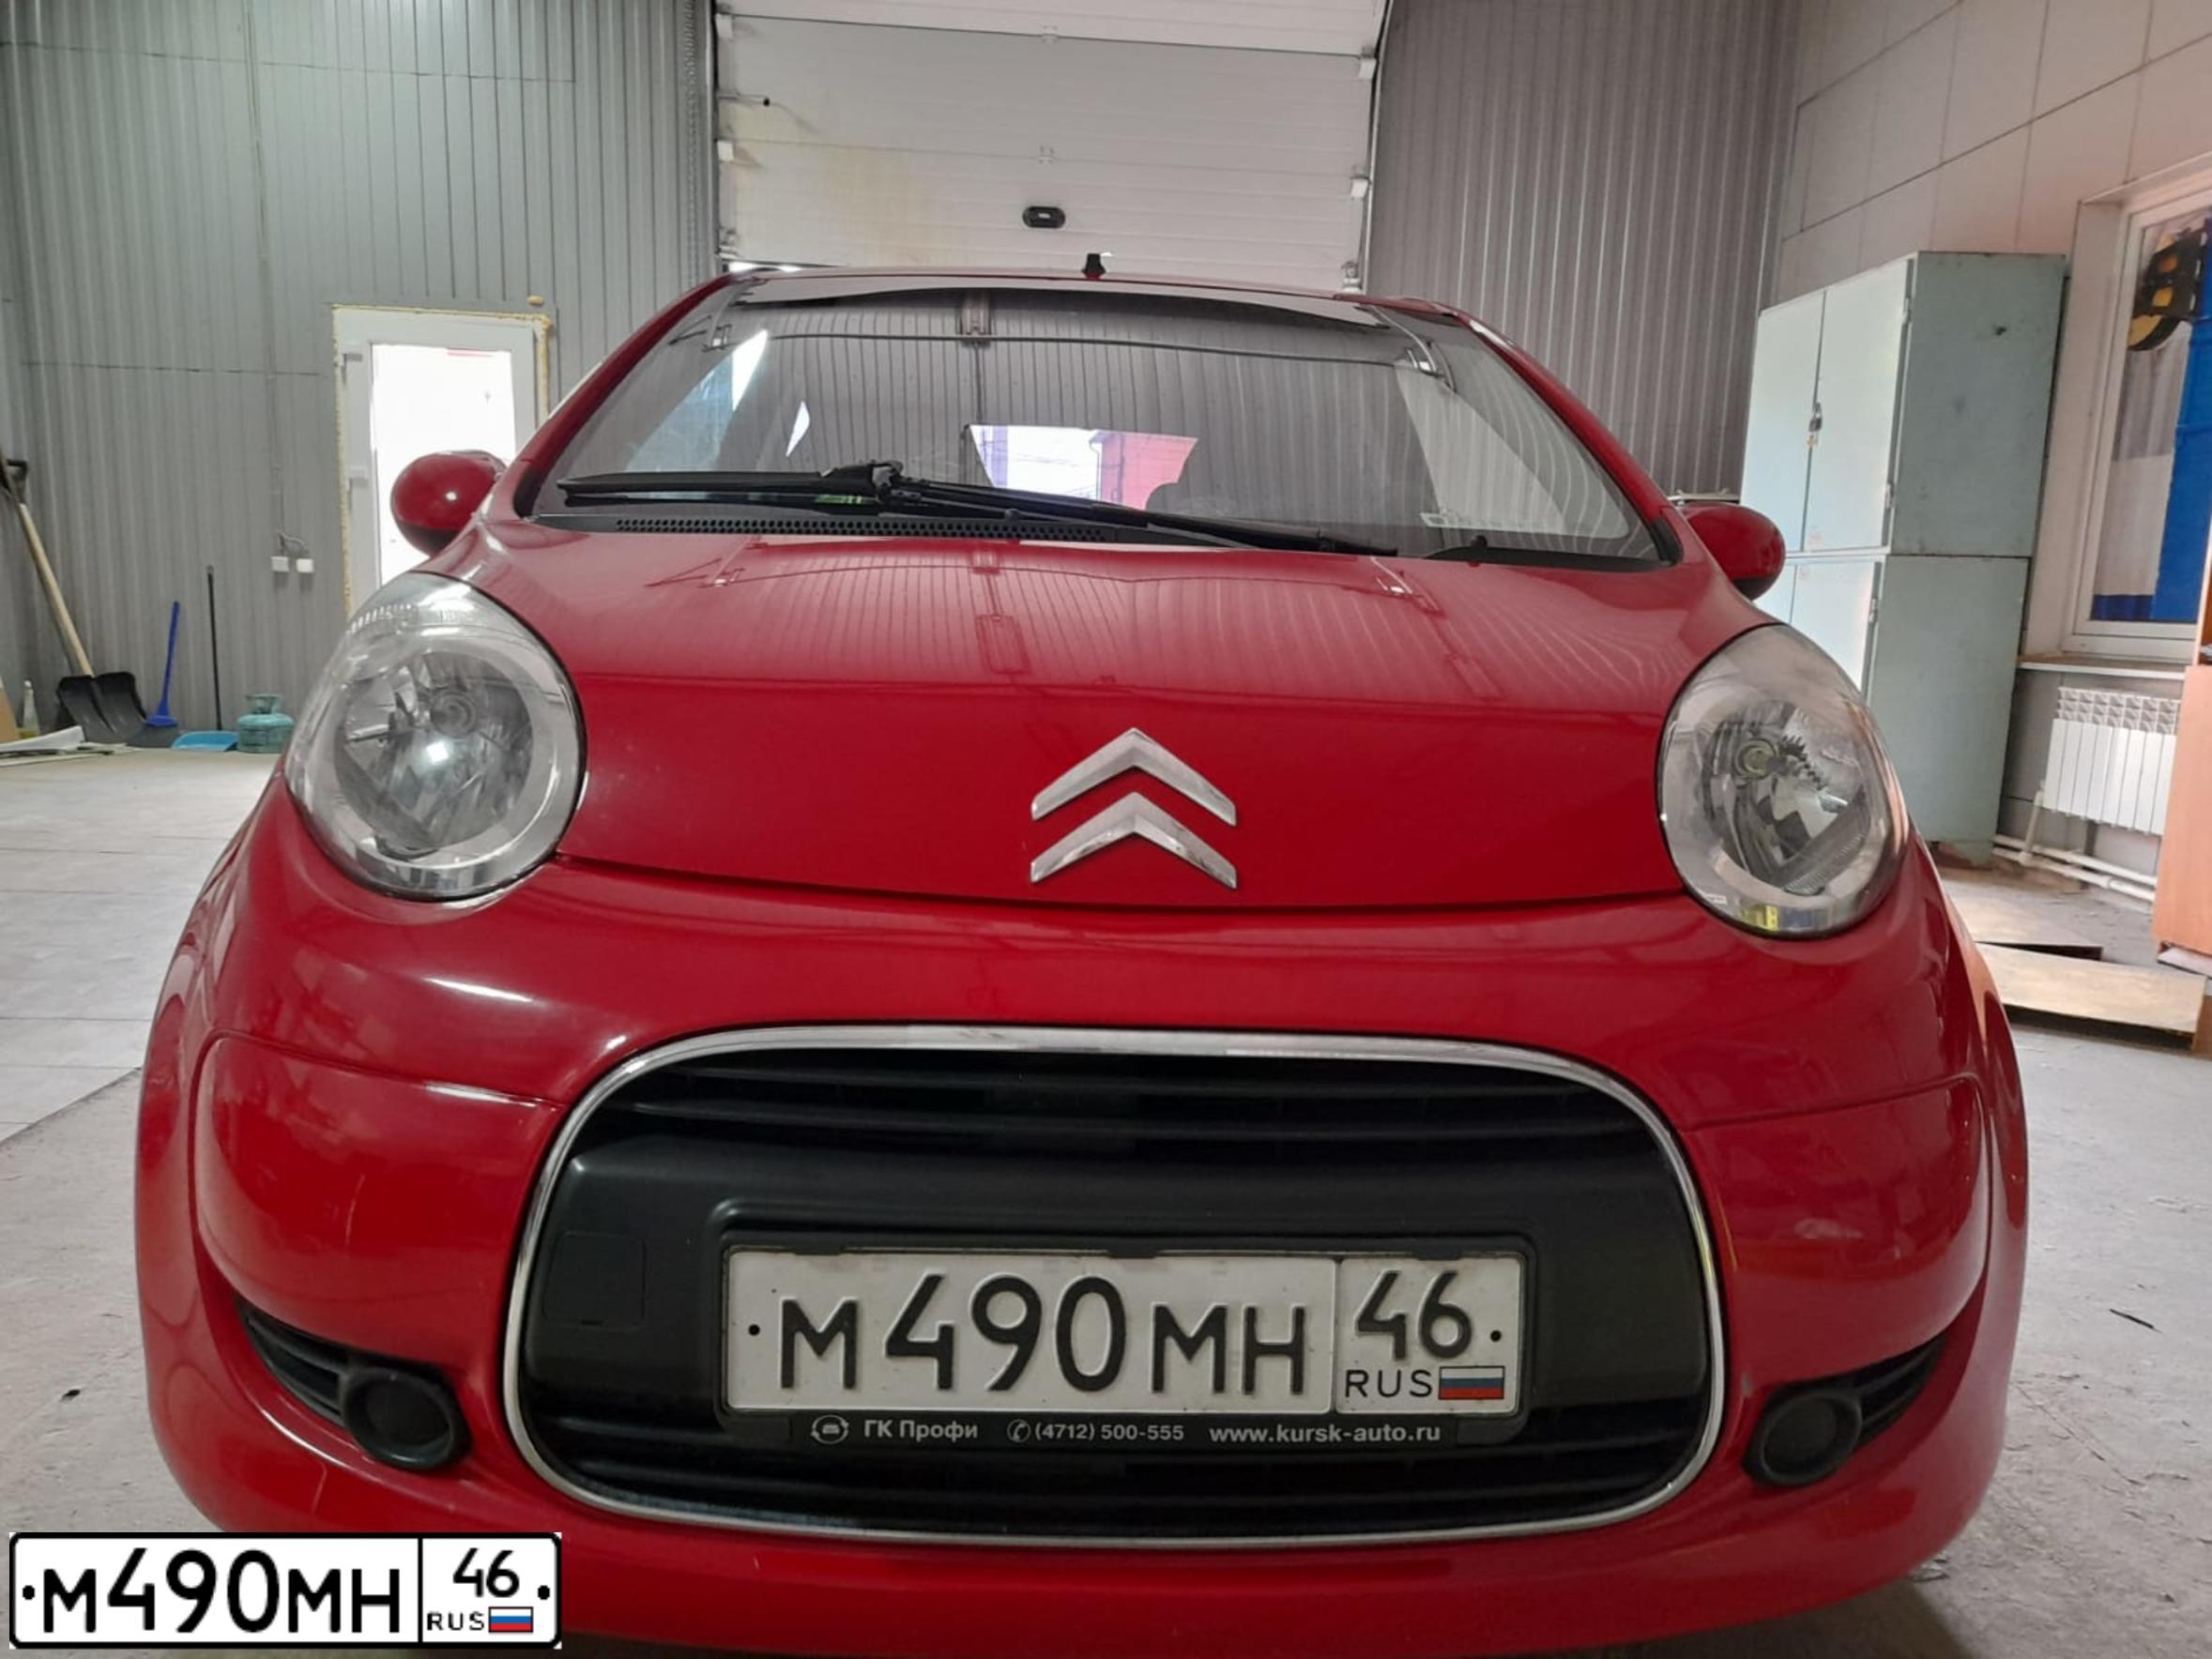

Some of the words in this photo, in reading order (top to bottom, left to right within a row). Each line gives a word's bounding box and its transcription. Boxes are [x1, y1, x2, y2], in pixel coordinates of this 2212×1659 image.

[1356, 1271, 1472, 1361] 46
[1345, 1369, 1433, 1398] RUS
[863, 1419, 892, 1438] ГК
[899, 1420, 979, 1442] Профи
[1034, 1422, 1096, 1440] (4712)
[1101, 1423, 1184, 1441] 500-555
[1209, 1423, 1442, 1442] www.kursk-auto.ru
